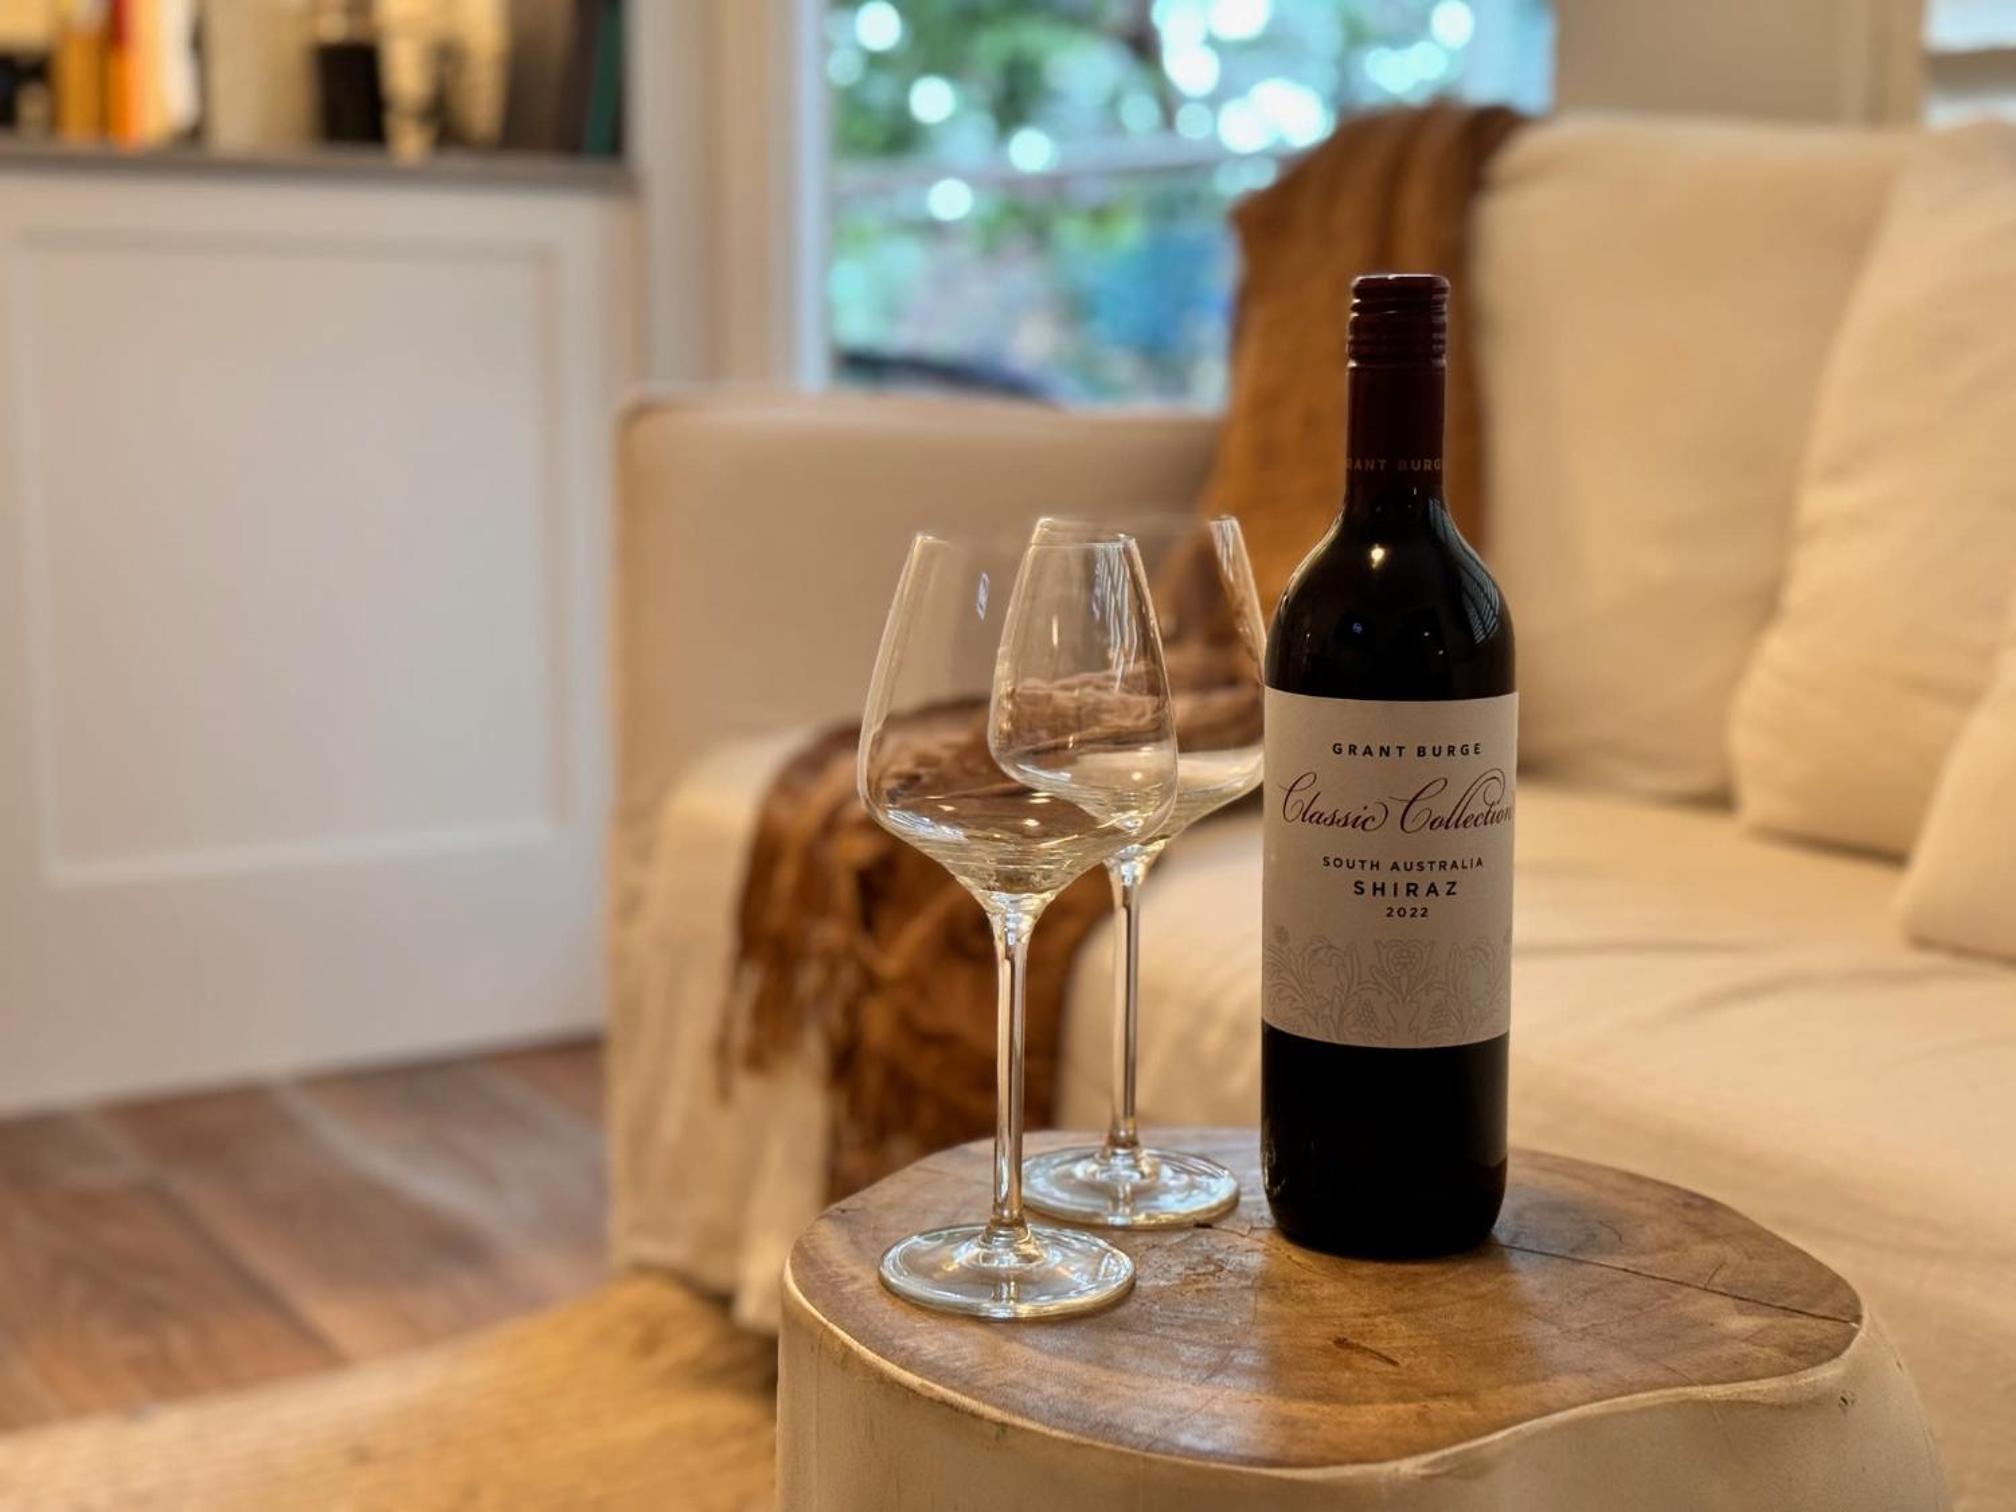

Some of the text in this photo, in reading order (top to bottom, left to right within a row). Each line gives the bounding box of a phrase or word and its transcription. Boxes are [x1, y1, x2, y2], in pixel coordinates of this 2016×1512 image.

[1397, 458, 1442, 472] BURG
[1332, 742, 1482, 758] GRANT BURGE
[1279, 767, 1512, 834] Classic Collection
[1322, 855, 1483, 872] SOUTH AUSTRALIA
[1353, 880, 1458, 897] SHIRAZ
[1385, 906, 1429, 919] 2022
